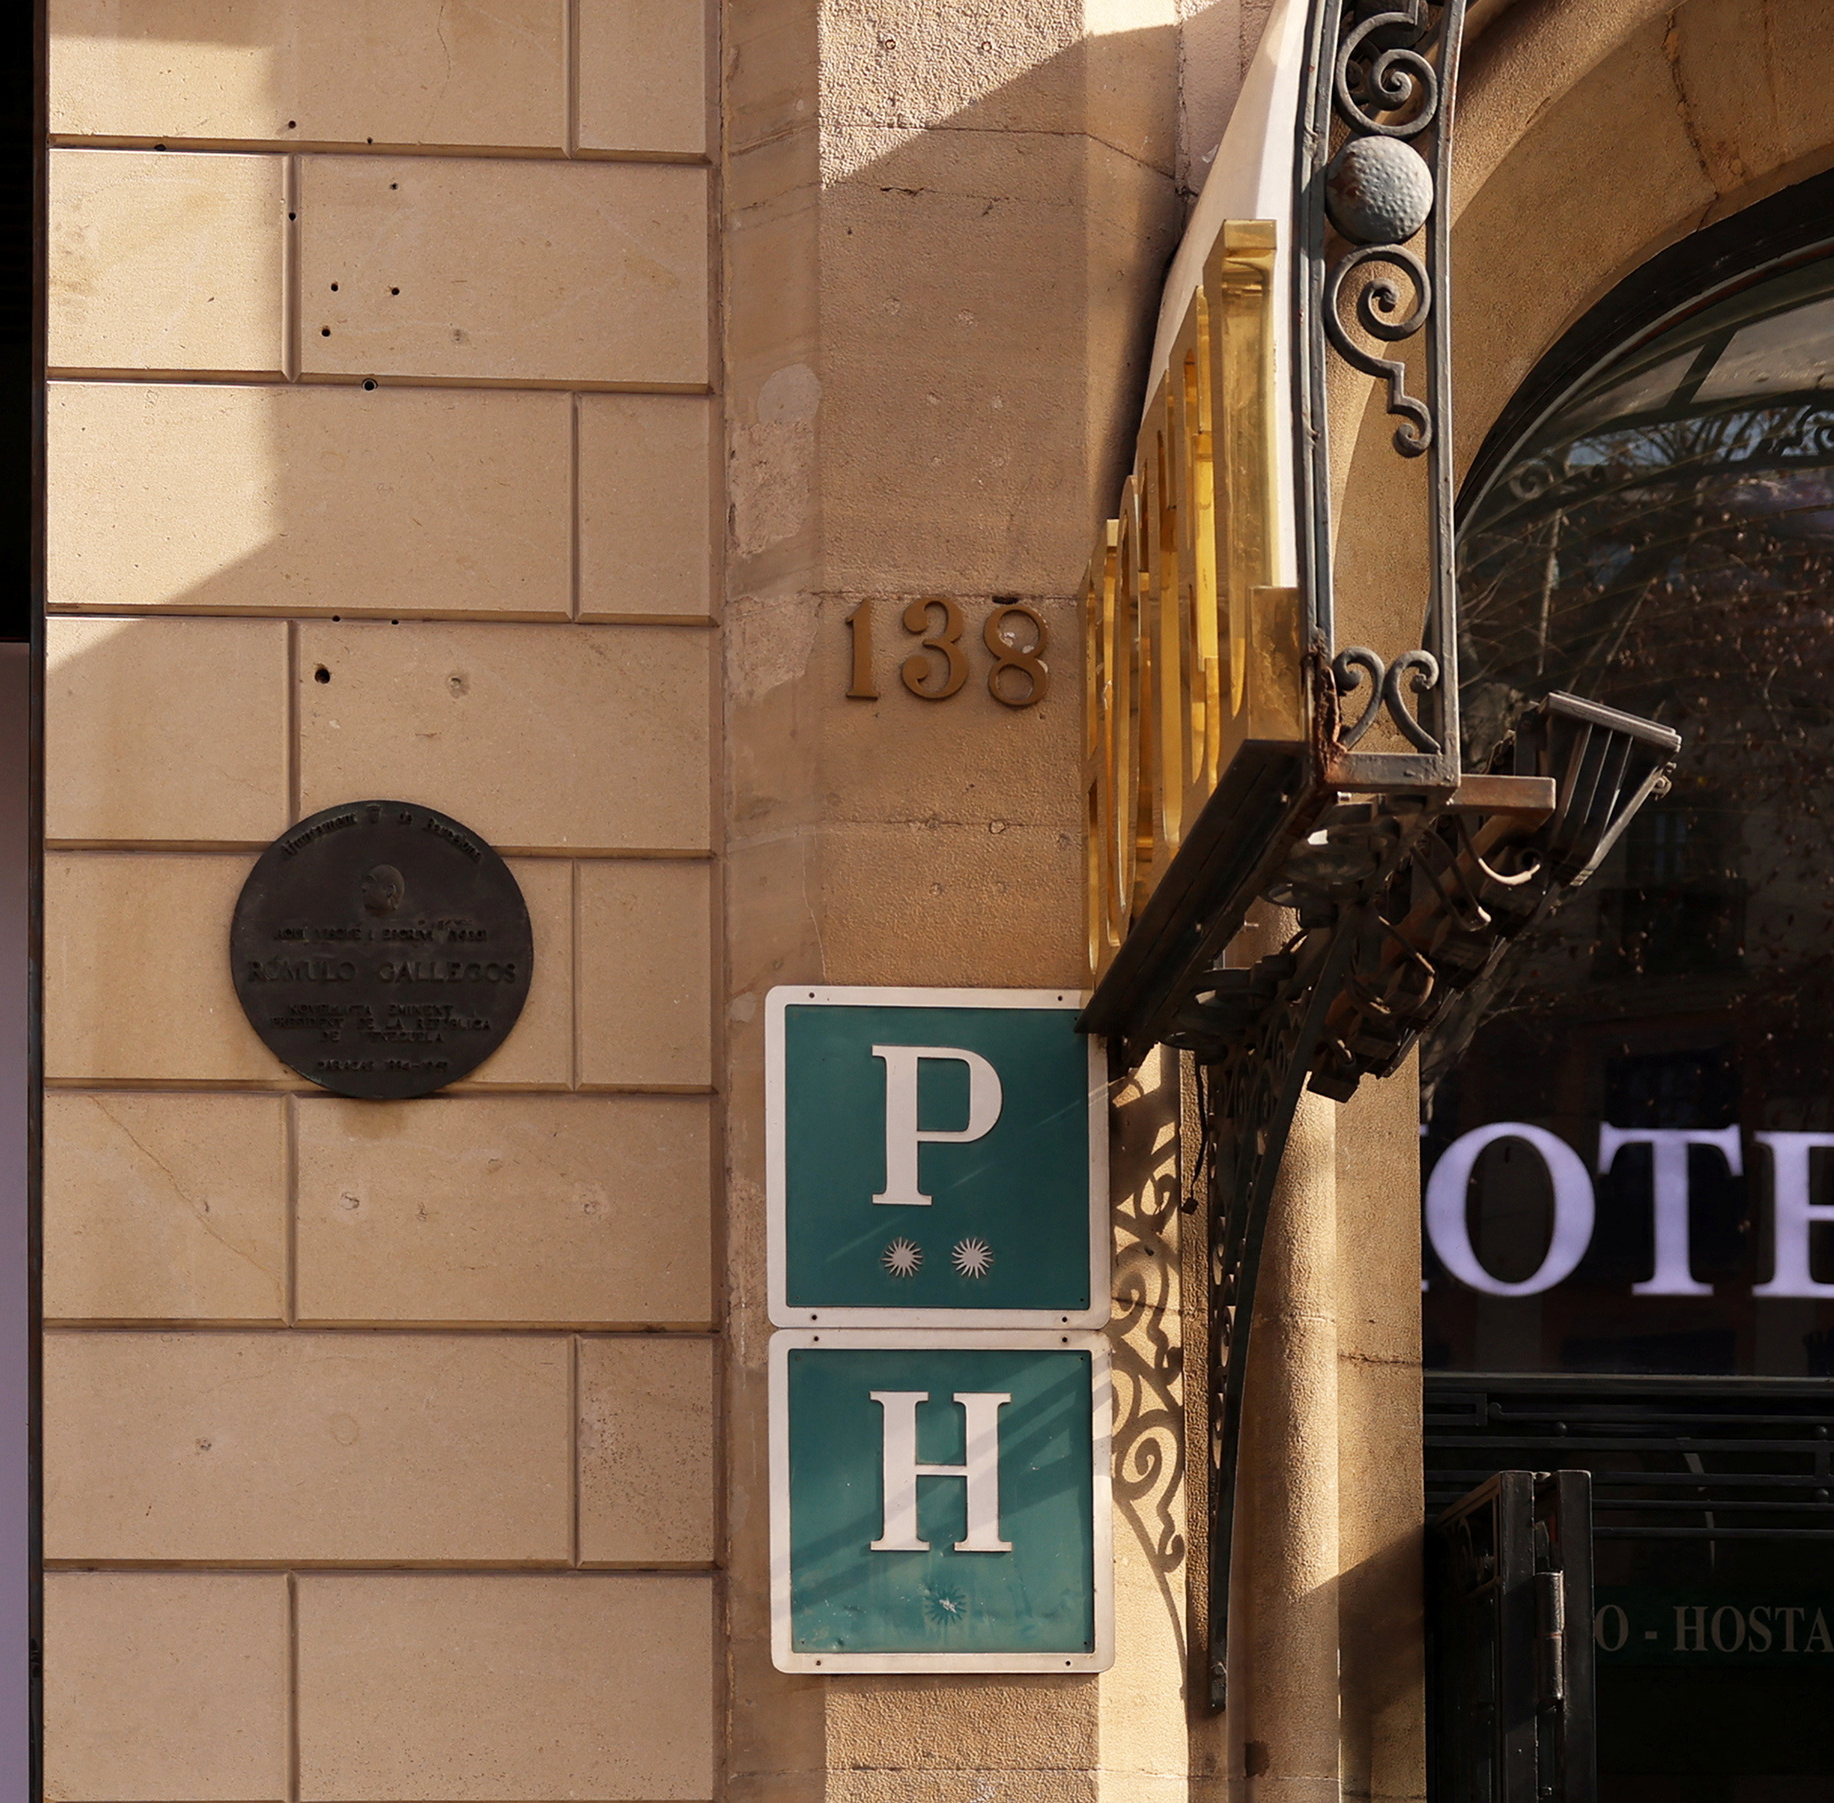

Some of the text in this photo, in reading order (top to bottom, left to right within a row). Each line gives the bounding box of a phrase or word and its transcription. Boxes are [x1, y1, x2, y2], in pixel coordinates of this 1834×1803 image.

[844, 594, 1049, 708] 138
[247, 953, 516, 984] RÓMULO GALLEGOS
[870, 1045, 1003, 1207] P
[869, 1390, 1013, 1554] H
